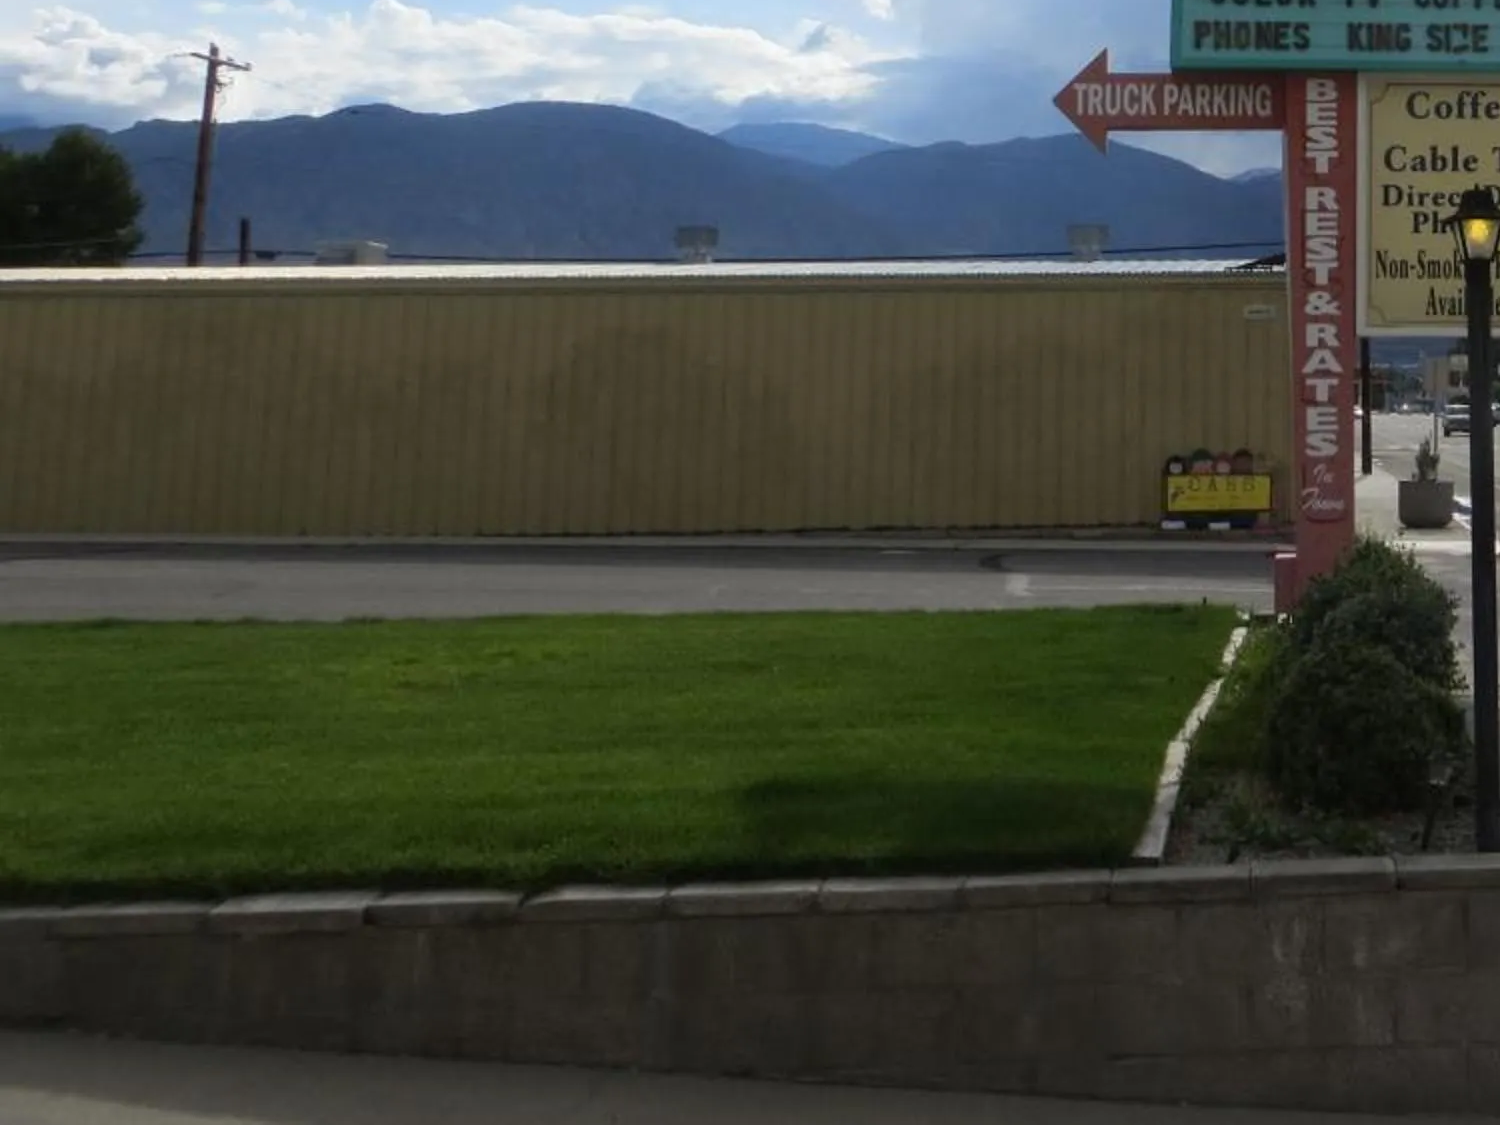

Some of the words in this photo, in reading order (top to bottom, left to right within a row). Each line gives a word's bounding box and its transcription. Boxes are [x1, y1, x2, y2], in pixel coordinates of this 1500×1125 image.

[1193, 20, 1311, 51] PHONES
[1347, 21, 1412, 54] KING
[1073, 82, 1157, 117] TRUCK
[1163, 82, 1273, 118] PARKING
[1305, 78, 1339, 174] BEST
[1383, 145, 1479, 173] Cable
[1381, 184, 1463, 207] Direc
[1305, 186, 1339, 285] REST
[1374, 250, 1470, 279] Non-Smok
[1304, 291, 1342, 316] &
[1302, 323, 1344, 457] RATES
